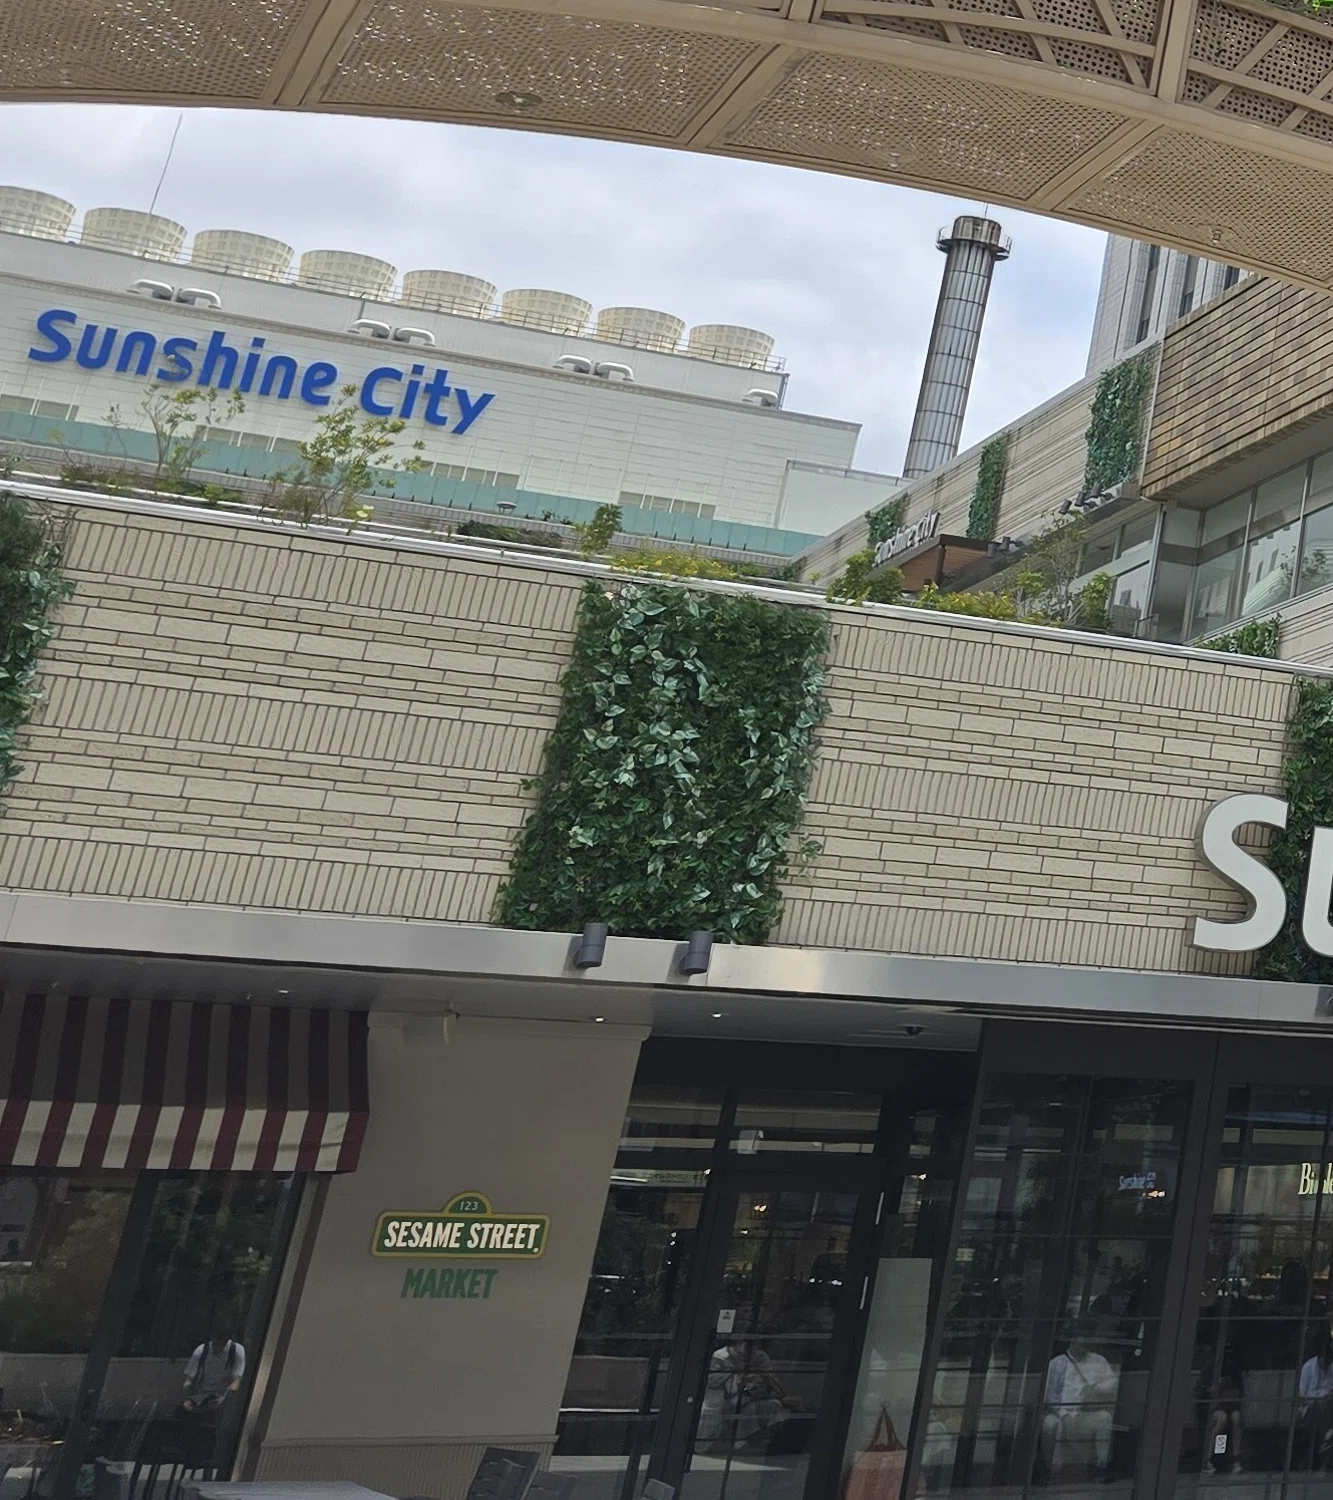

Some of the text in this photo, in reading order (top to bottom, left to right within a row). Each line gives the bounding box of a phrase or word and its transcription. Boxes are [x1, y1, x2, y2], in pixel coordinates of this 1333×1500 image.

[28, 309, 496, 435] Sunshine City
[458, 1200, 479, 1211] 123
[384, 1221, 465, 1248] SESAME
[400, 1267, 499, 1299] MARKET
